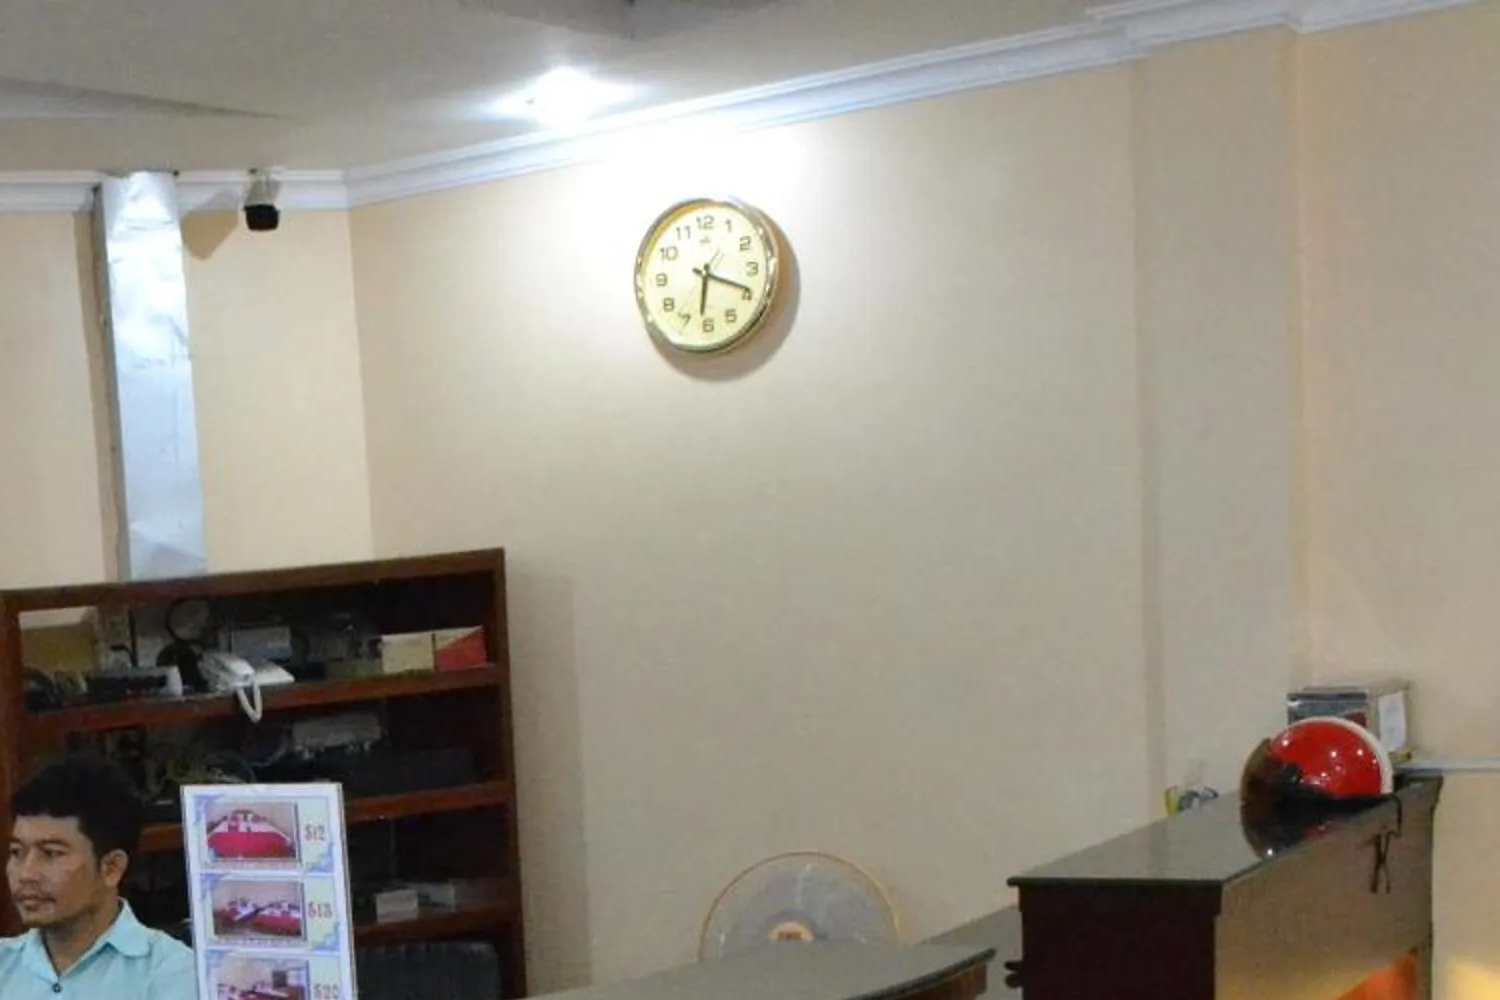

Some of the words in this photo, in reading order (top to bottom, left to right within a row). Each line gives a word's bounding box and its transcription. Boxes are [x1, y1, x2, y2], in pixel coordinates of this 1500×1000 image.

[696, 215, 714, 230] 12
[725, 219, 732, 233] 1
[676, 226, 691, 241] 11
[739, 235, 751, 251] 2
[660, 246, 678, 261] 10
[746, 261, 758, 276] 3
[655, 273, 667, 287] 9
[663, 297, 674, 312] 8
[678, 311, 691, 325] 7
[725, 309, 737, 323] 5
[702, 318, 714, 333] 6
[304, 824, 326, 842] $12
